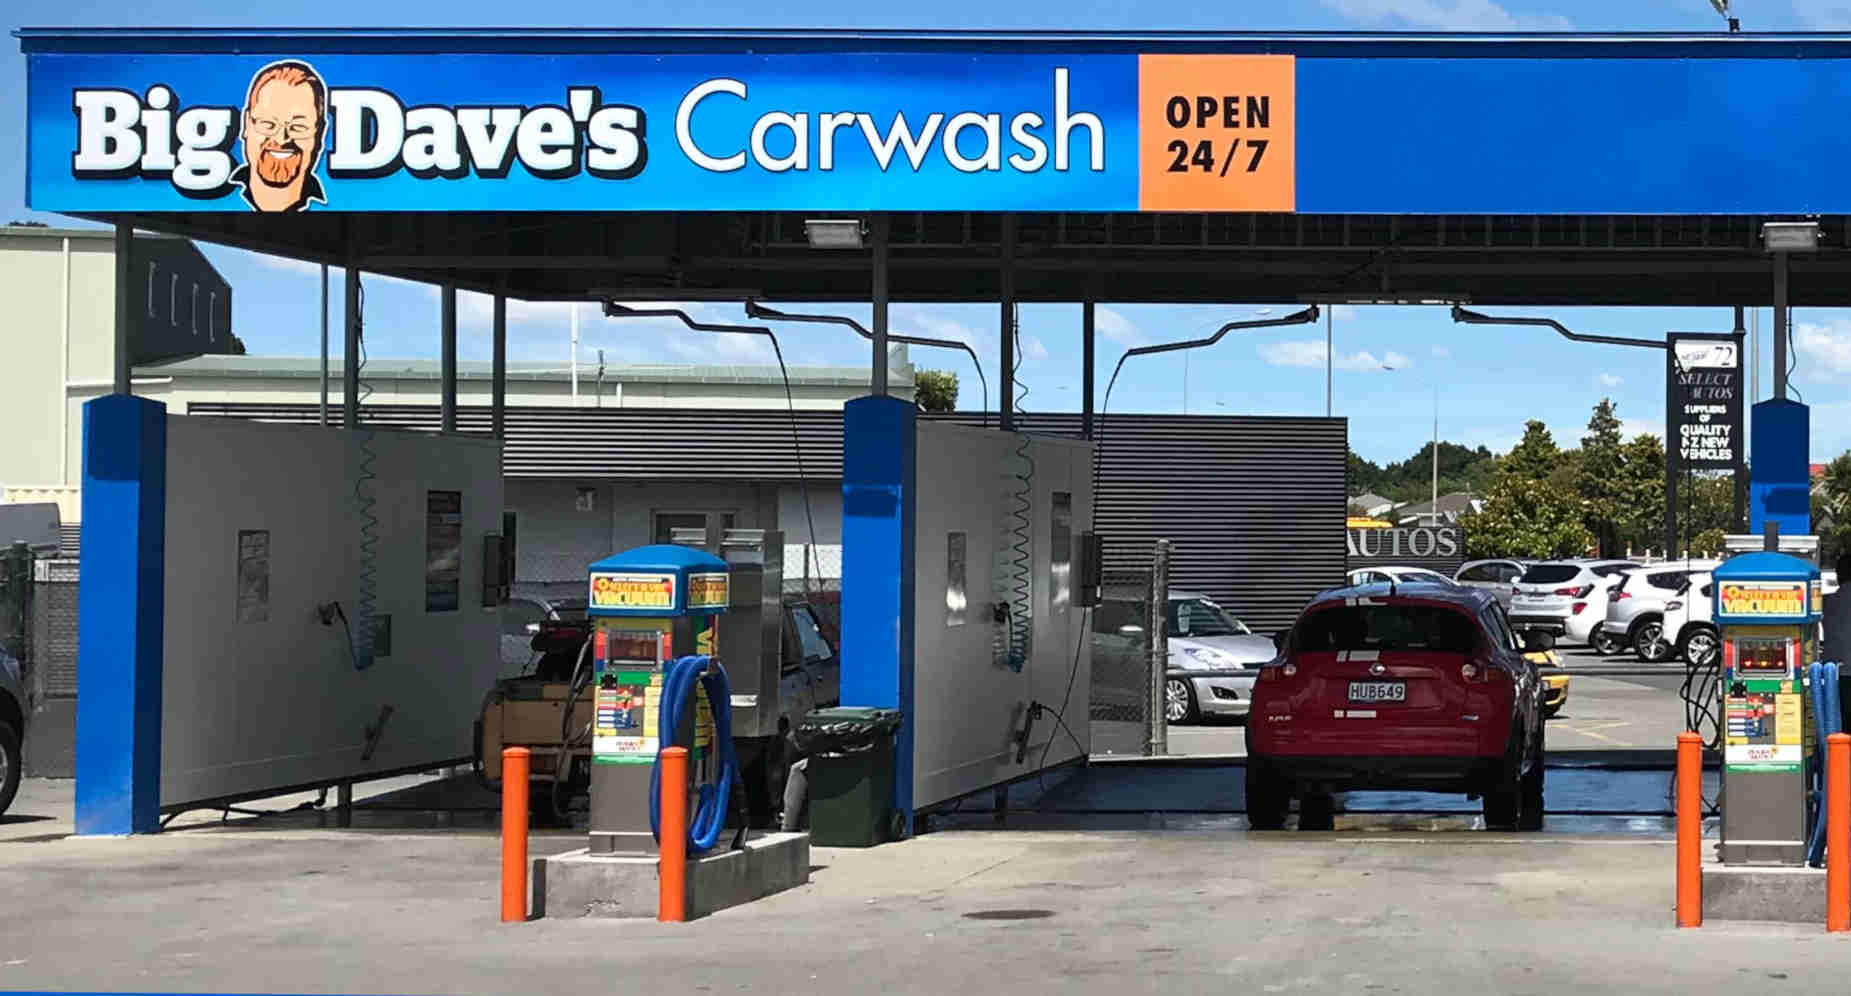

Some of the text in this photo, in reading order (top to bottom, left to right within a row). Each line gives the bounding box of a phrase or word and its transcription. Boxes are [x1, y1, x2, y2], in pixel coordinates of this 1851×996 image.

[1167, 96, 1269, 128] OPEN
[73, 67, 1104, 195] Big Dave's Carwash
[1167, 138, 1269, 177] 24/7
[1679, 373, 1732, 385] SELECT
[1684, 404, 1727, 414] SUPPLIERS
[1699, 414, 1711, 423] OF
[1680, 424, 1732, 437] QUALITY
[1700, 437, 1730, 448] NEW
[1680, 448, 1733, 460] VEHICLES
[1350, 684, 1404, 699] HUB649
